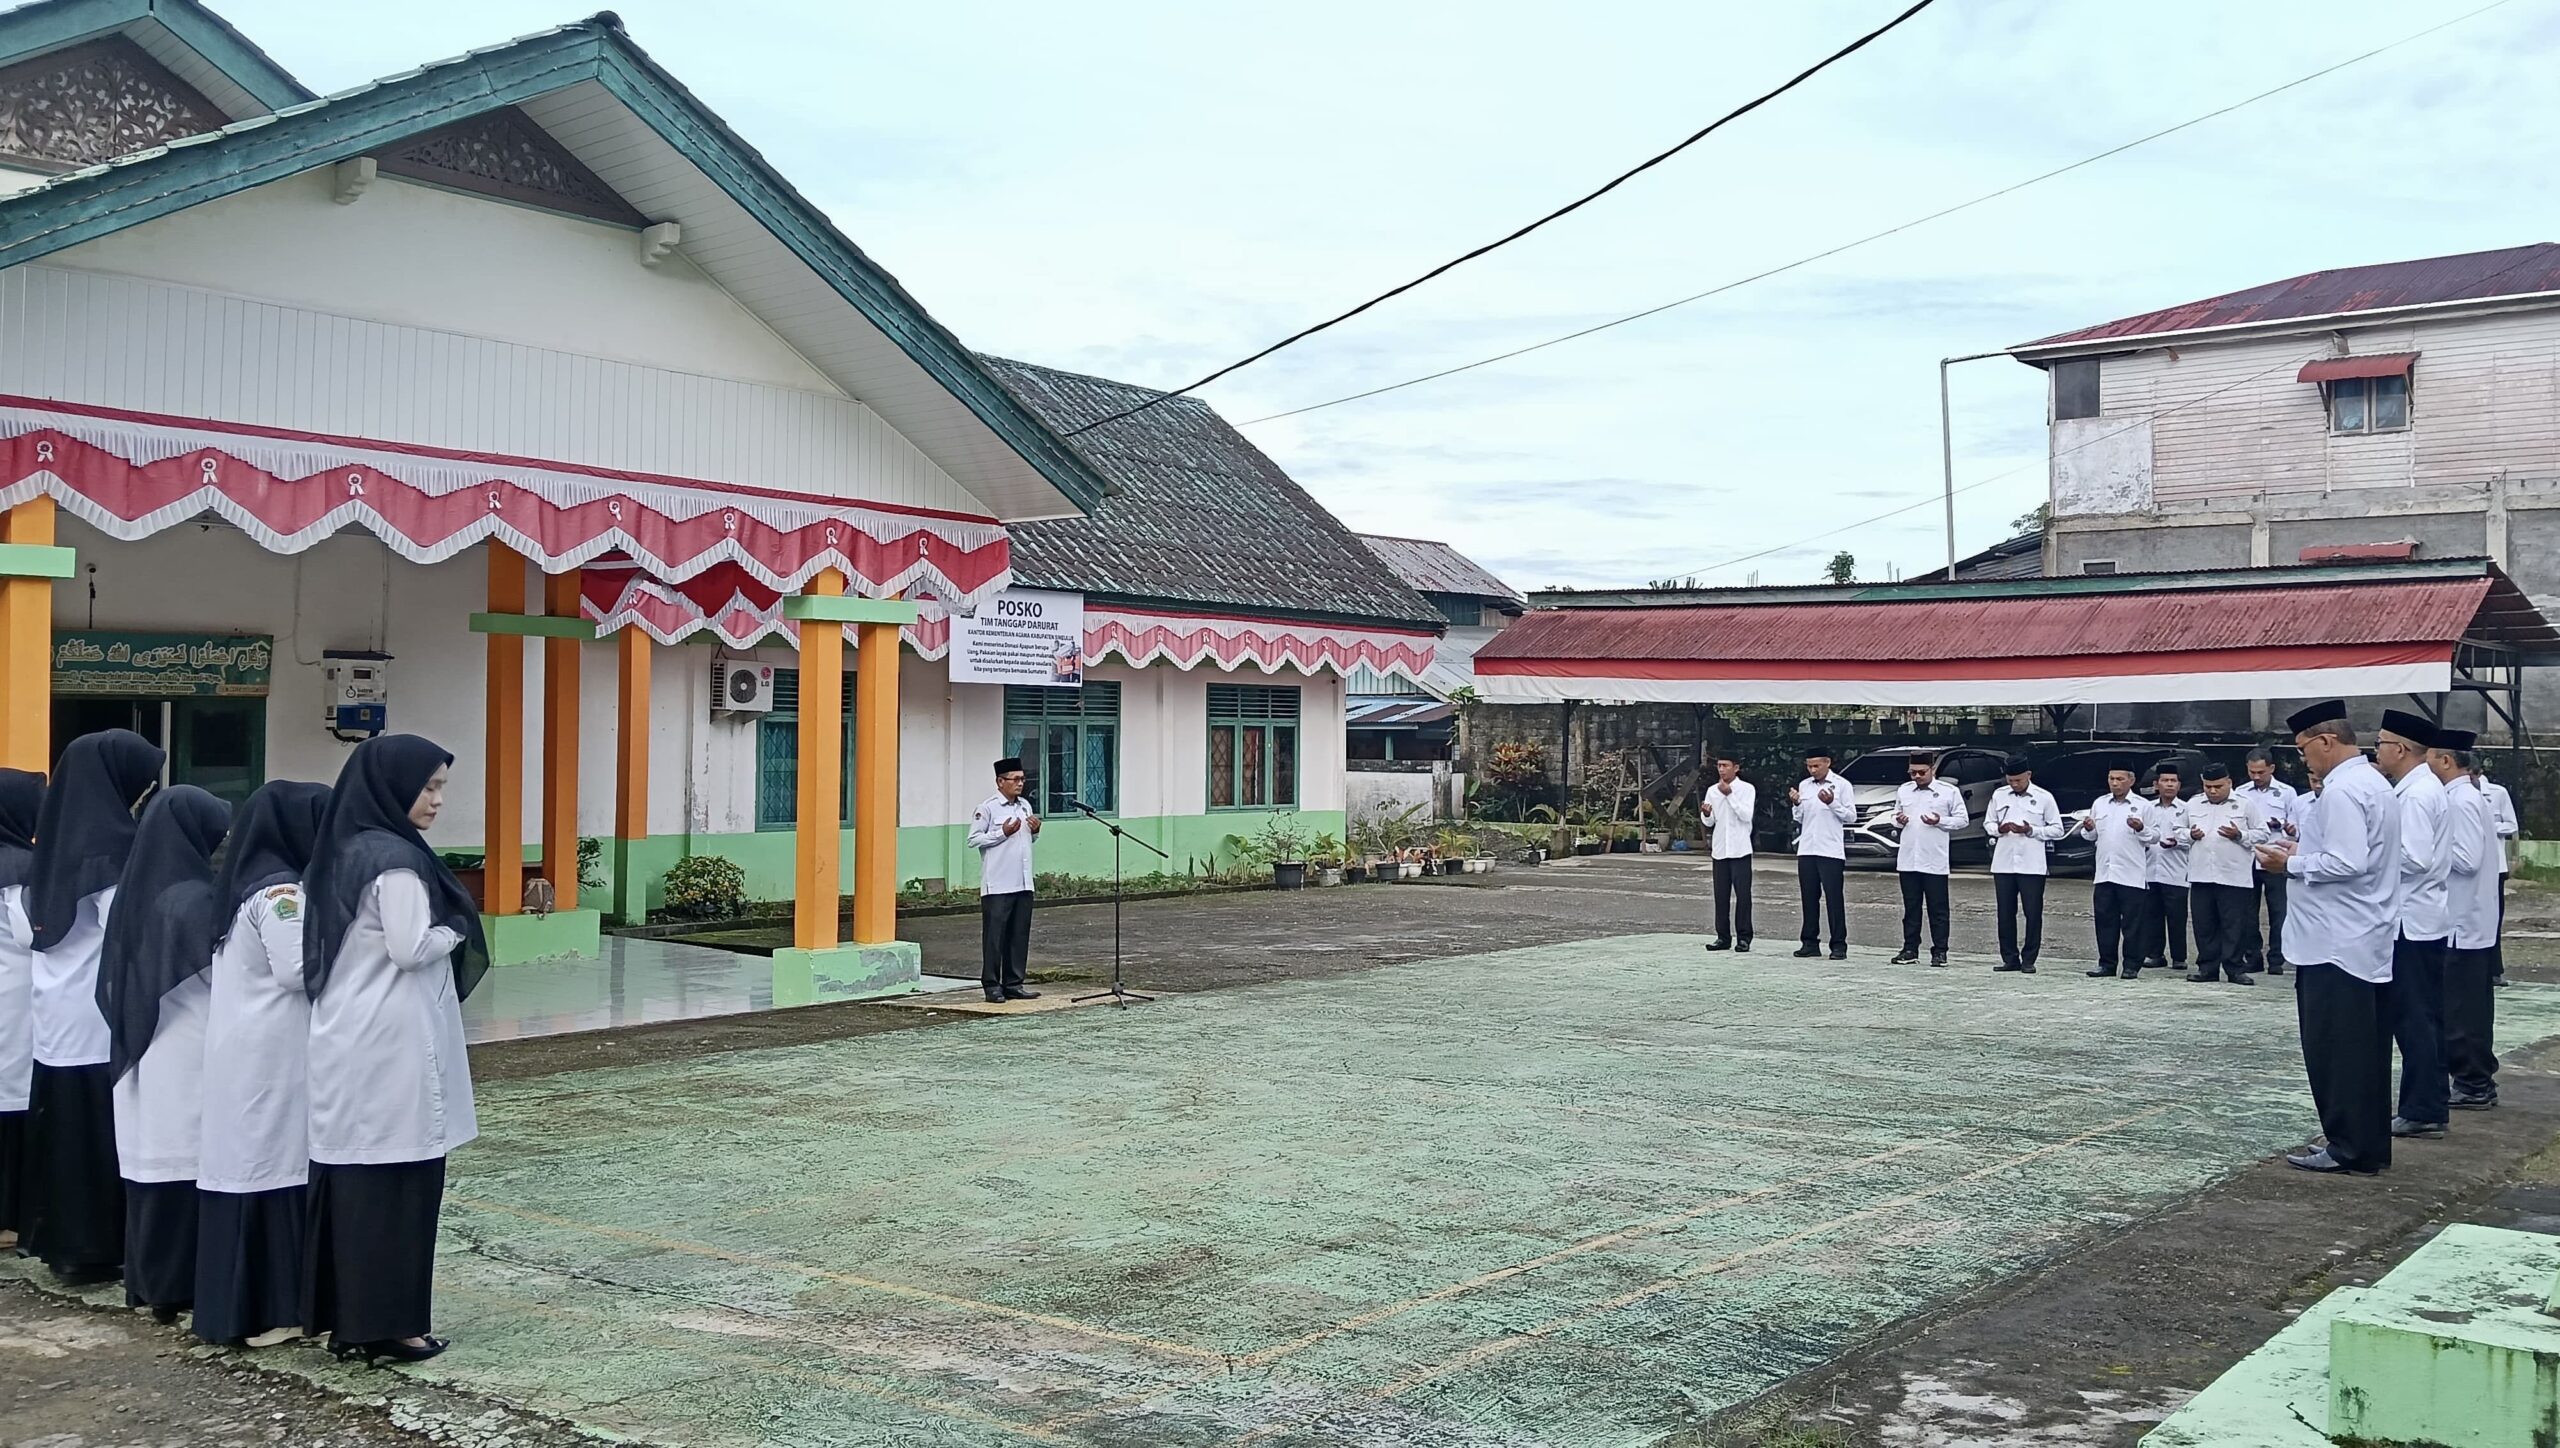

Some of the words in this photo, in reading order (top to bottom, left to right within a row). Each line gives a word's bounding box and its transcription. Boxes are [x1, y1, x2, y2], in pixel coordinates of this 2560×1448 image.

[997, 600, 1043, 618] POSKO
[980, 617, 994, 627] TIM
[994, 618, 1026, 629] TANGGAP
[1027, 620, 1060, 631] DARURAT
[986, 630, 1015, 638] KEMENTERIAN
[1030, 632, 1055, 640] KABUPATEN
[1004, 641, 1019, 649] Donasi
[1019, 642, 1035, 651] Apapun
[1034, 643, 1049, 651] berupa
[995, 650, 1007, 658] layak
[1007, 650, 1019, 658] pakai
